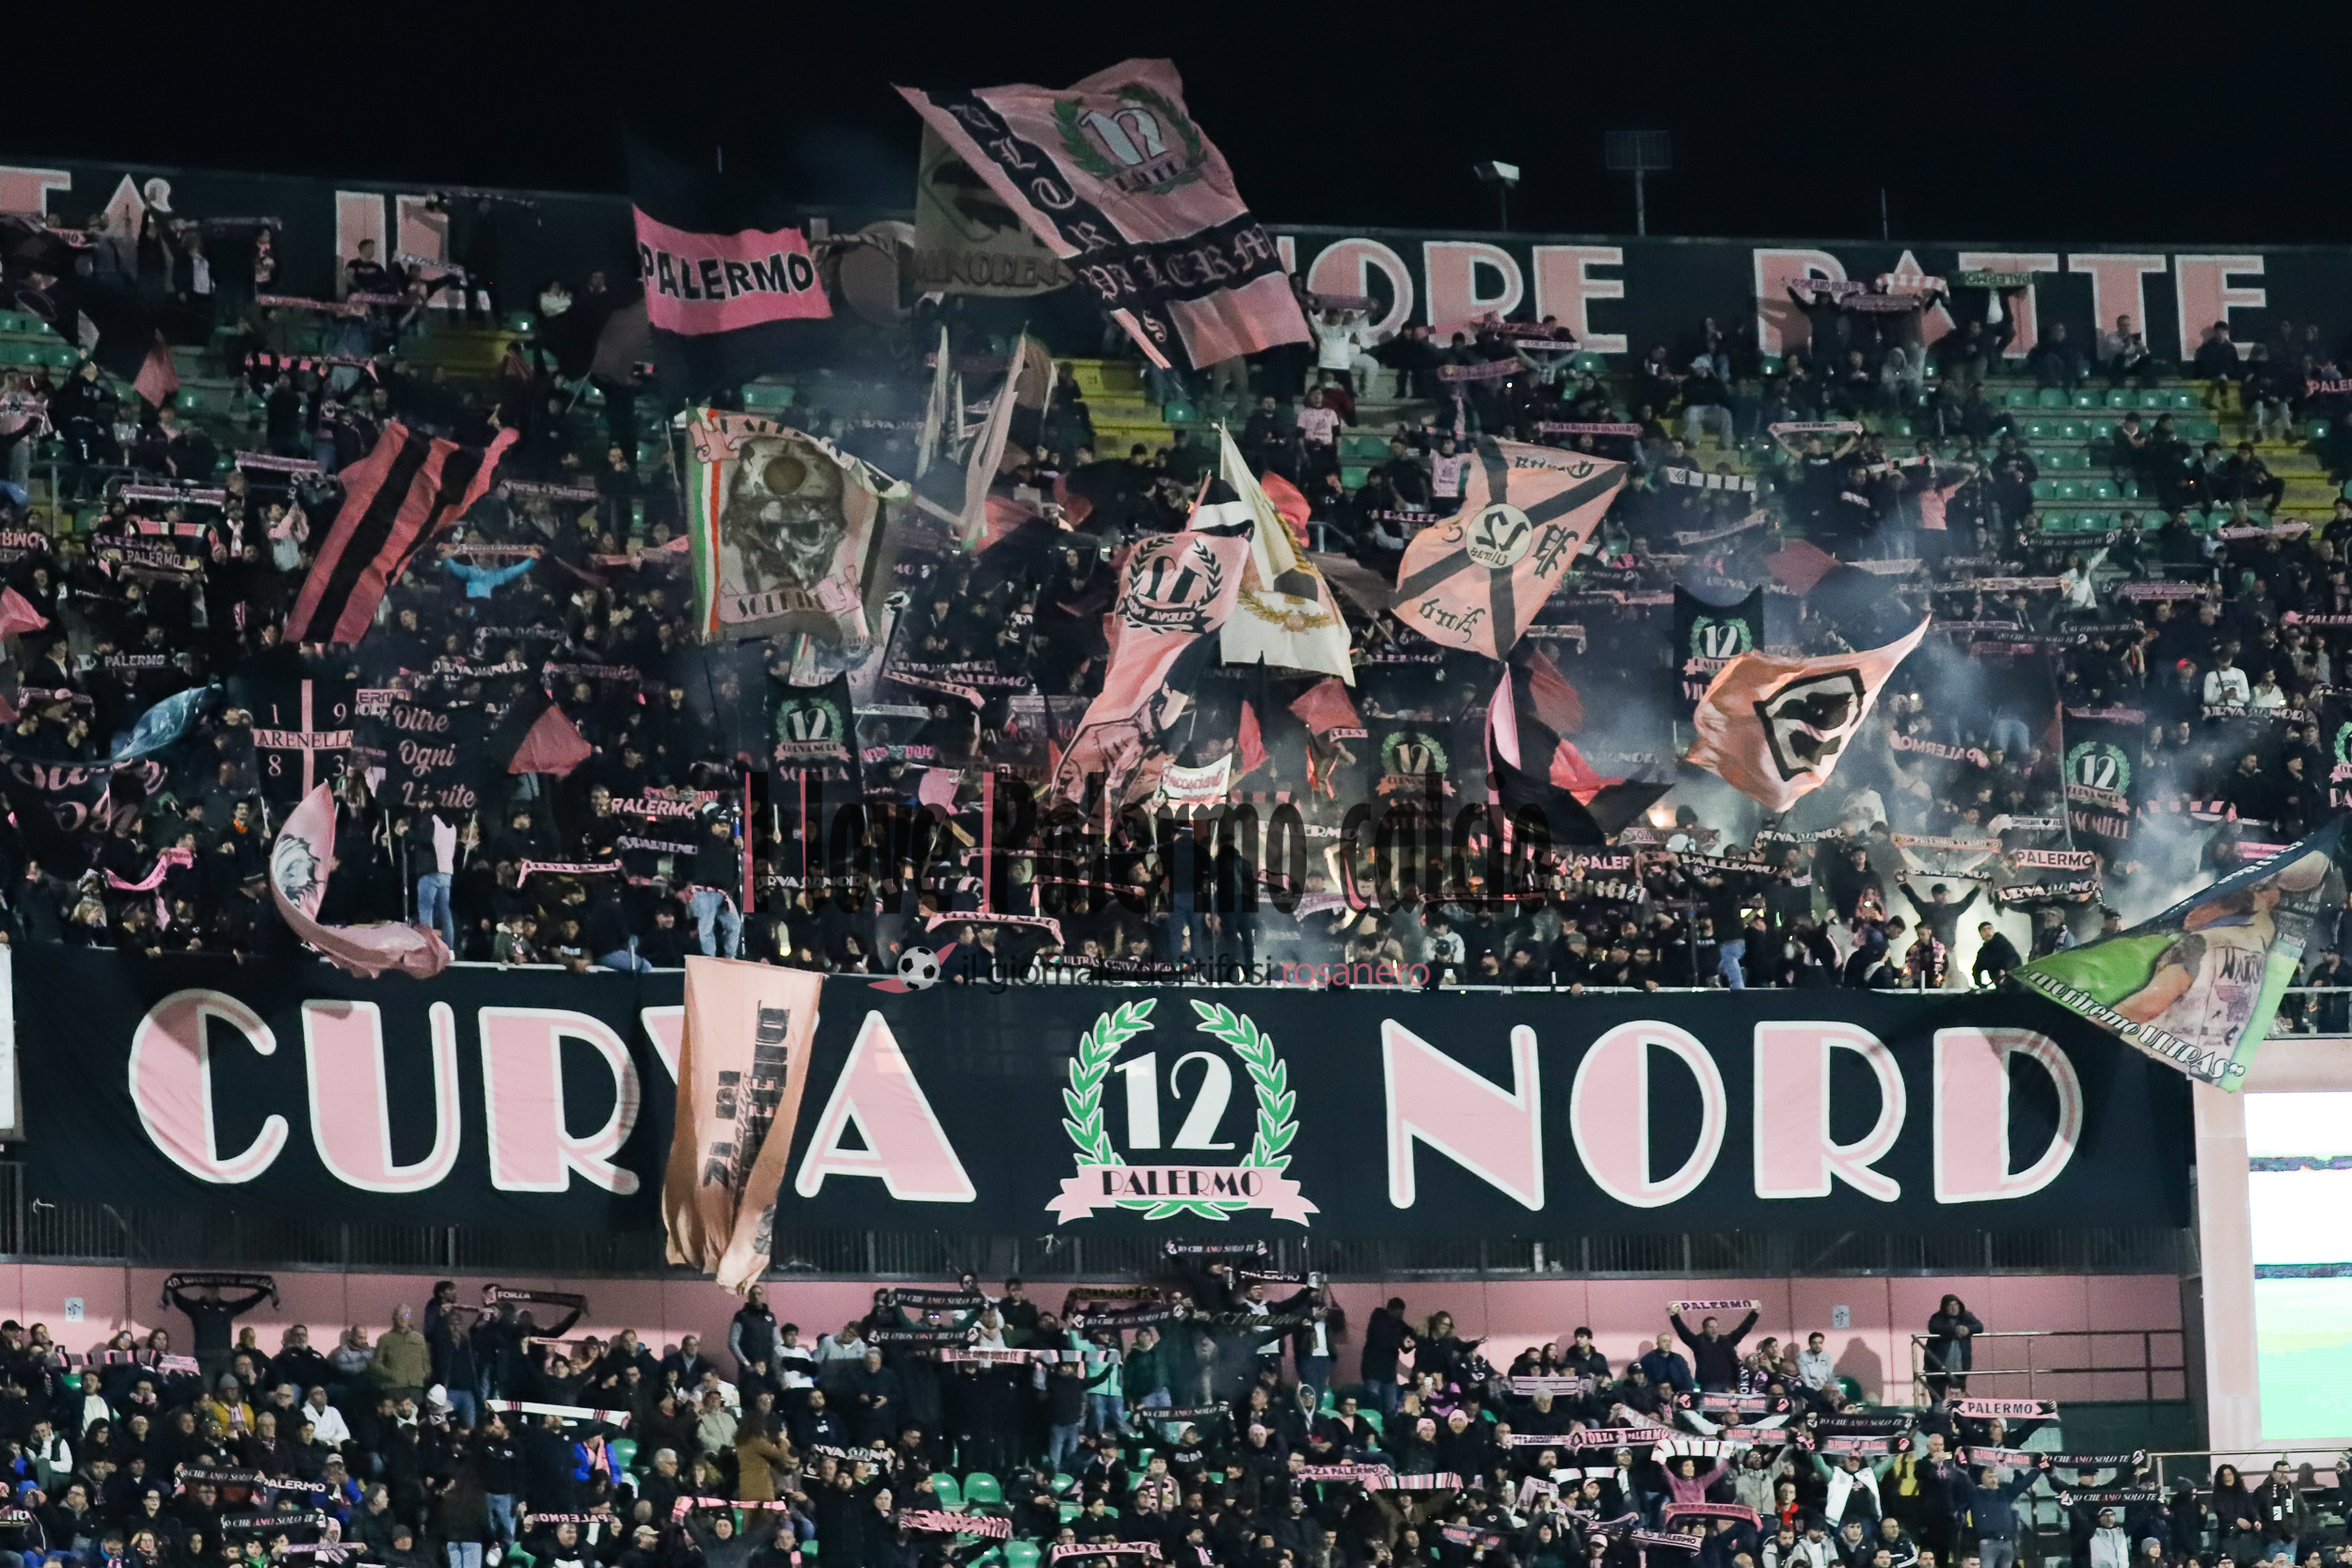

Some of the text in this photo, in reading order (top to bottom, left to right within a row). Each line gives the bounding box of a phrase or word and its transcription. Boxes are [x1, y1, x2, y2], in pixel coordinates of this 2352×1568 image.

[1078, 106, 1168, 166] 12
[640, 243, 814, 301] PALERMO
[125, 550, 182, 566] PALERMO
[1703, 625, 1738, 658] 12
[104, 654, 166, 668] PALERMO
[271, 704, 279, 724] 1
[333, 703, 348, 723] 9
[392, 704, 450, 732] Oltre
[790, 707, 833, 743] 12
[258, 729, 353, 749] ARENELLA
[267, 754, 345, 777] 8 3
[398, 739, 455, 777] Ogni
[2081, 754, 2117, 791] 12
[2016, 850, 2095, 867] PALERMO
[1997, 884, 2045, 902] URVA
[127, 988, 2084, 1212] CURA NORD
[1113, 1050, 1236, 1150] 12
[1102, 1168, 1263, 1197] PALERMO
[1681, 1300, 1752, 1311] PALERMO
[1967, 1402, 2033, 1415] PALERMO
[2054, 1454, 2130, 1464] CHE AMO SOLO TE
[188, 1469, 205, 1478] CHE
[209, 1471, 227, 1481] AMO
[230, 1473, 252, 1481] SOLO
[1298, 1466, 1327, 1477] ORZA
[2084, 1493, 2101, 1502] CHE
[2102, 1493, 2122, 1502] AMO
[2124, 1493, 2145, 1502] SOLO
[2147, 1493, 2157, 1502] TE
[233, 1518, 250, 1528] CHE
[253, 1517, 274, 1527] AMO
[277, 1516, 302, 1526] SOLO
[1658, 1533, 1697, 1544] PALERMO
